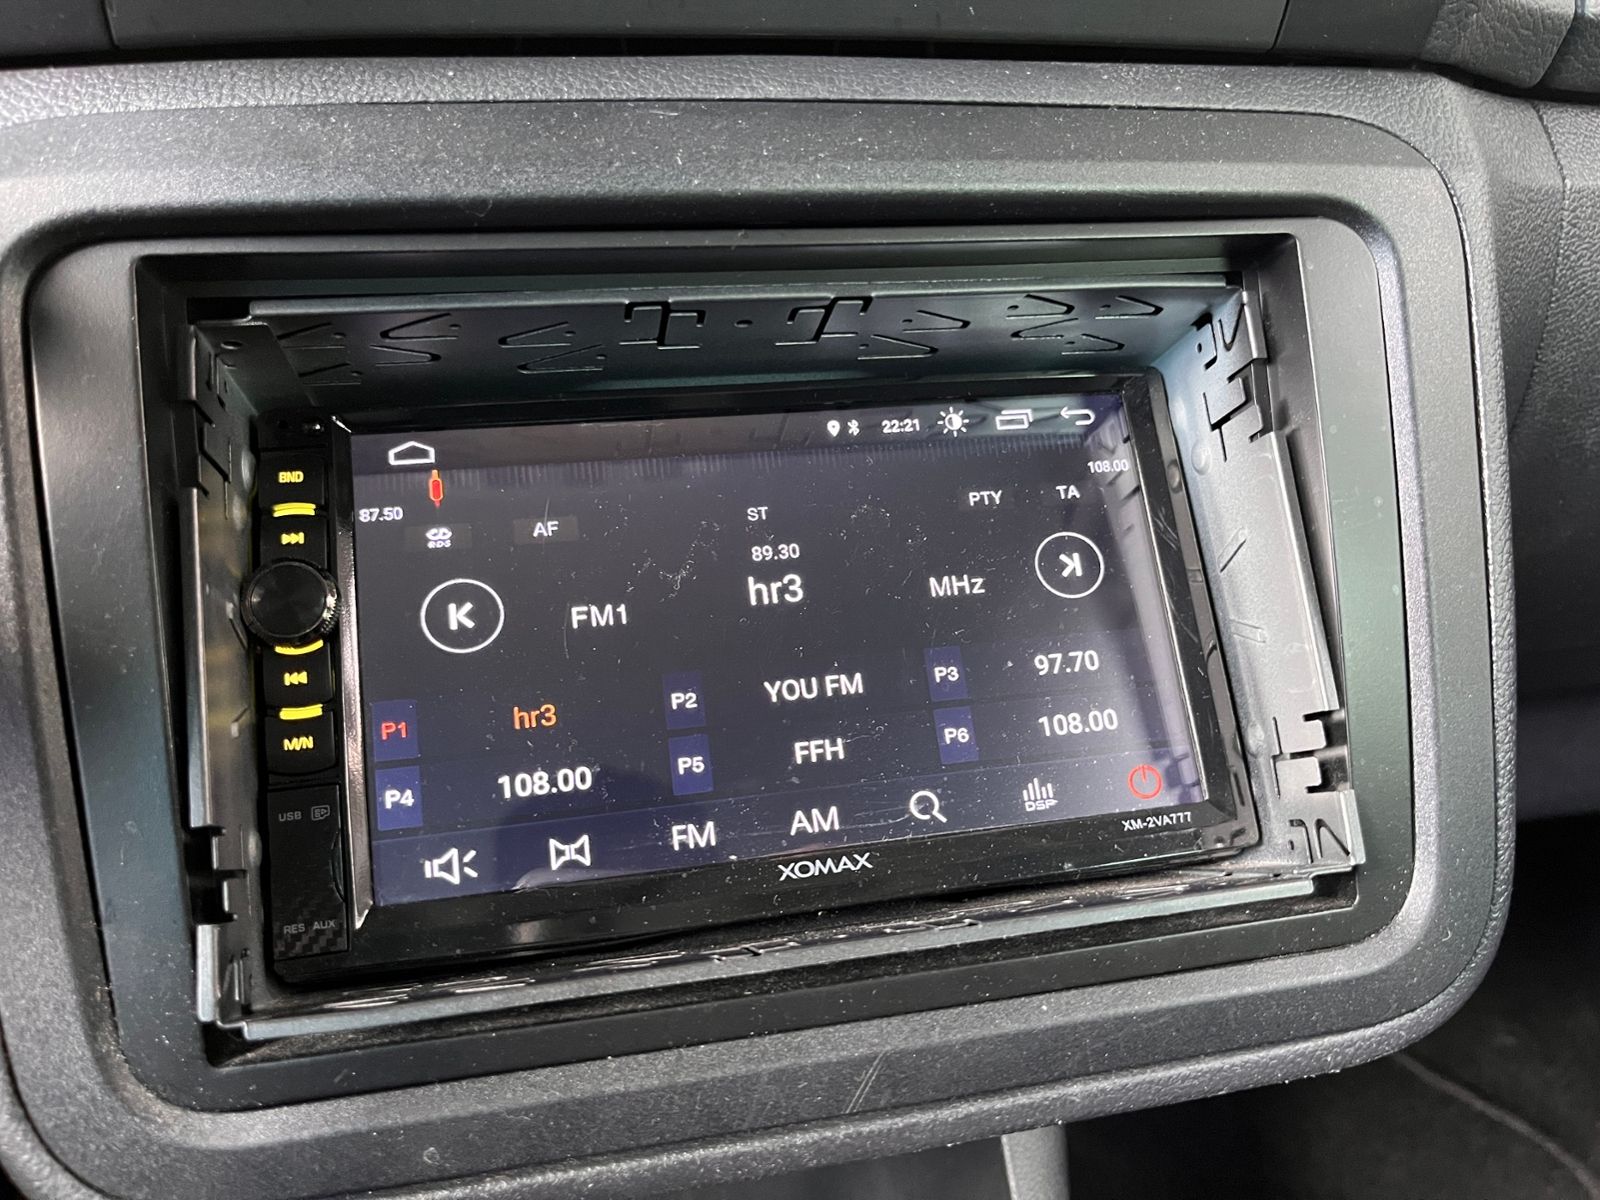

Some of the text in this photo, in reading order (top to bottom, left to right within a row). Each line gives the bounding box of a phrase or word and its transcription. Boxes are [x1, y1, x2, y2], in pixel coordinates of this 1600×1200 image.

[881, 418, 921, 434] 22:21
[1087, 458, 1129, 475] 108.00
[278, 470, 304, 484] BND
[968, 490, 1003, 507] PTY
[1055, 484, 1081, 500] TA
[358, 506, 404, 523] 87.50
[746, 506, 769, 522] ST
[532, 520, 559, 538] AF
[751, 542, 801, 562] 89.30
[747, 574, 803, 606] hr3
[928, 574, 986, 598] MHz
[570, 603, 627, 630] FM1
[1033, 650, 1101, 677] 97.70
[933, 666, 960, 683] P3
[763, 672, 864, 703] YOU FM
[670, 692, 698, 710] P2
[513, 703, 557, 730] hr3
[1036, 708, 1120, 739] 108.00
[380, 721, 407, 741] P1
[943, 727, 970, 745] P6
[794, 737, 846, 765] FFH
[677, 756, 705, 775] P5
[497, 766, 593, 799] 108.00
[384, 788, 415, 810] P4
[1024, 800, 1055, 812] DSP
[278, 810, 303, 822] USB
[789, 805, 841, 836] AM
[1121, 811, 1193, 832] XM-2VA777
[671, 820, 717, 851] FM
[777, 851, 873, 881] XOMAX
[312, 919, 336, 931] AUX
